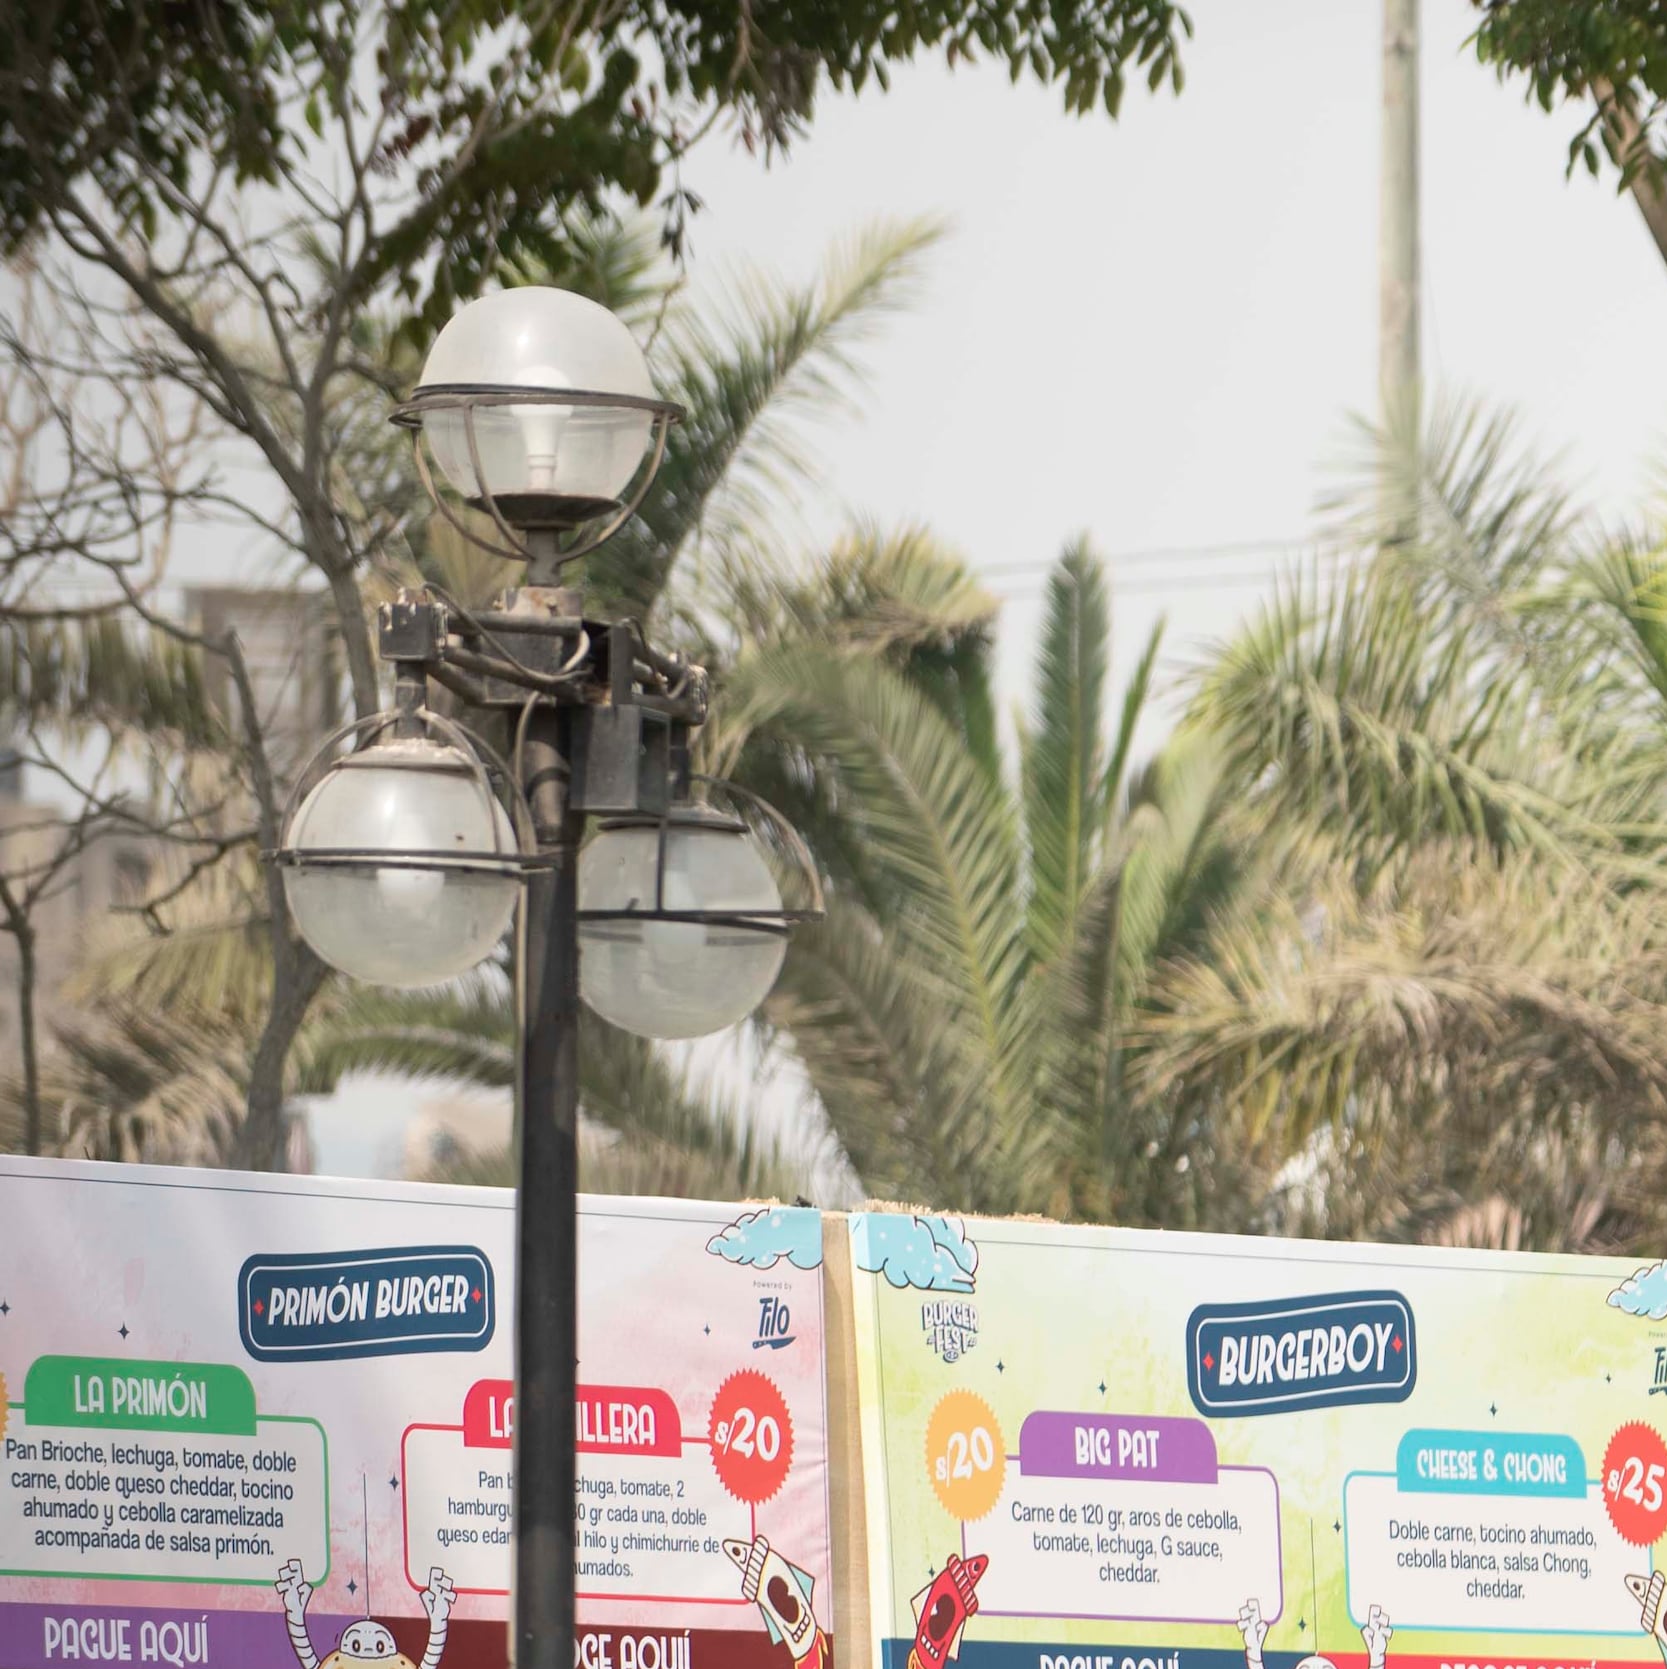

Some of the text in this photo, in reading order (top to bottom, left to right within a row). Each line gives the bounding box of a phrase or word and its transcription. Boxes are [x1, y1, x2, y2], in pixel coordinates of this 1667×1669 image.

[268, 1274, 469, 1326] PRIMÓN BURGER
[922, 1300, 979, 1332] BURGER
[934, 1326, 972, 1355] FEST
[1218, 1322, 1393, 1387] BURGERBOY
[74, 1373, 207, 1418] LA PRIMÓN
[6, 1437, 296, 1474] Pan Brioche, lechuga, tomate, doble
[1075, 1426, 1160, 1469] BIG PAT
[479, 1470, 503, 1489] Pan
[1417, 1448, 1567, 1485] CHEESE & CHONG
[11, 1468, 293, 1501] carne, doble queso cheddar, tocino
[620, 1477, 673, 1500] tomate,
[677, 1479, 684, 1497] 2
[23, 1495, 283, 1528] ahumado y cebolla caramelizada
[590, 1510, 602, 1528] gr
[607, 1504, 637, 1523] cada
[642, 1511, 667, 1527] una,
[672, 1506, 706, 1525] doble
[1011, 1502, 1241, 1533] Carne de 120 gr, aros de cebolla,
[35, 1524, 273, 1562] acompañada de salsa primón.
[437, 1530, 478, 1549] queso
[584, 1530, 606, 1549] hilo
[610, 1537, 618, 1555] y
[622, 1532, 699, 1552] chimichurrie
[703, 1535, 720, 1553] de
[1033, 1531, 1222, 1561] tomate, lechuga, G sauce,
[1389, 1520, 1596, 1548] Doble carne, tocino ahumado,
[1099, 1561, 1159, 1583] cheddar.
[1397, 1549, 1590, 1578] cebolla blanca, salsa Chong,
[1466, 1578, 1524, 1598] cheddar.
[44, 1615, 208, 1668] PAGUE AQUÍ
